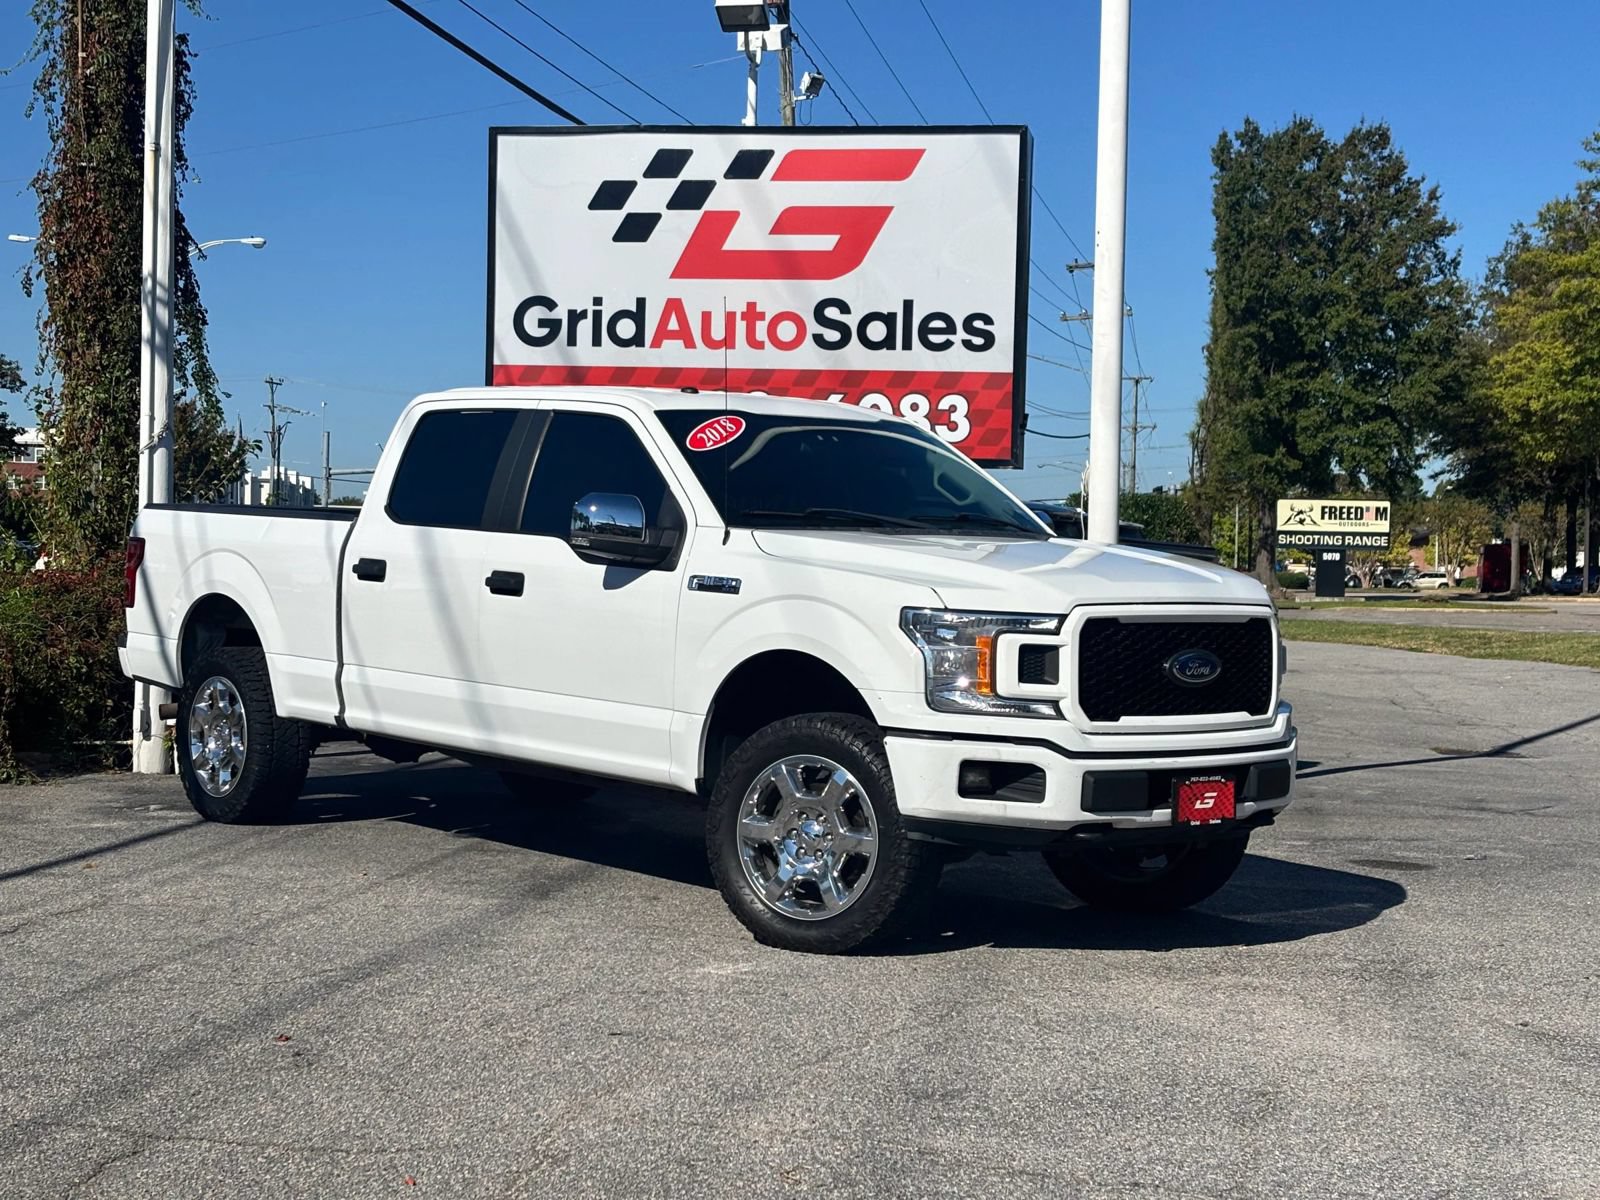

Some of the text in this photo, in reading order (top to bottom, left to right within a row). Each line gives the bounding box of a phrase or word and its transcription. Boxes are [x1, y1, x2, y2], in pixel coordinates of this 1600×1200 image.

[513, 295, 996, 353] GridAutoSales
[697, 418, 736, 447] 2018
[1278, 534, 1388, 546] SHOOTING RANGE
[1186, 660, 1211, 675] Ford
